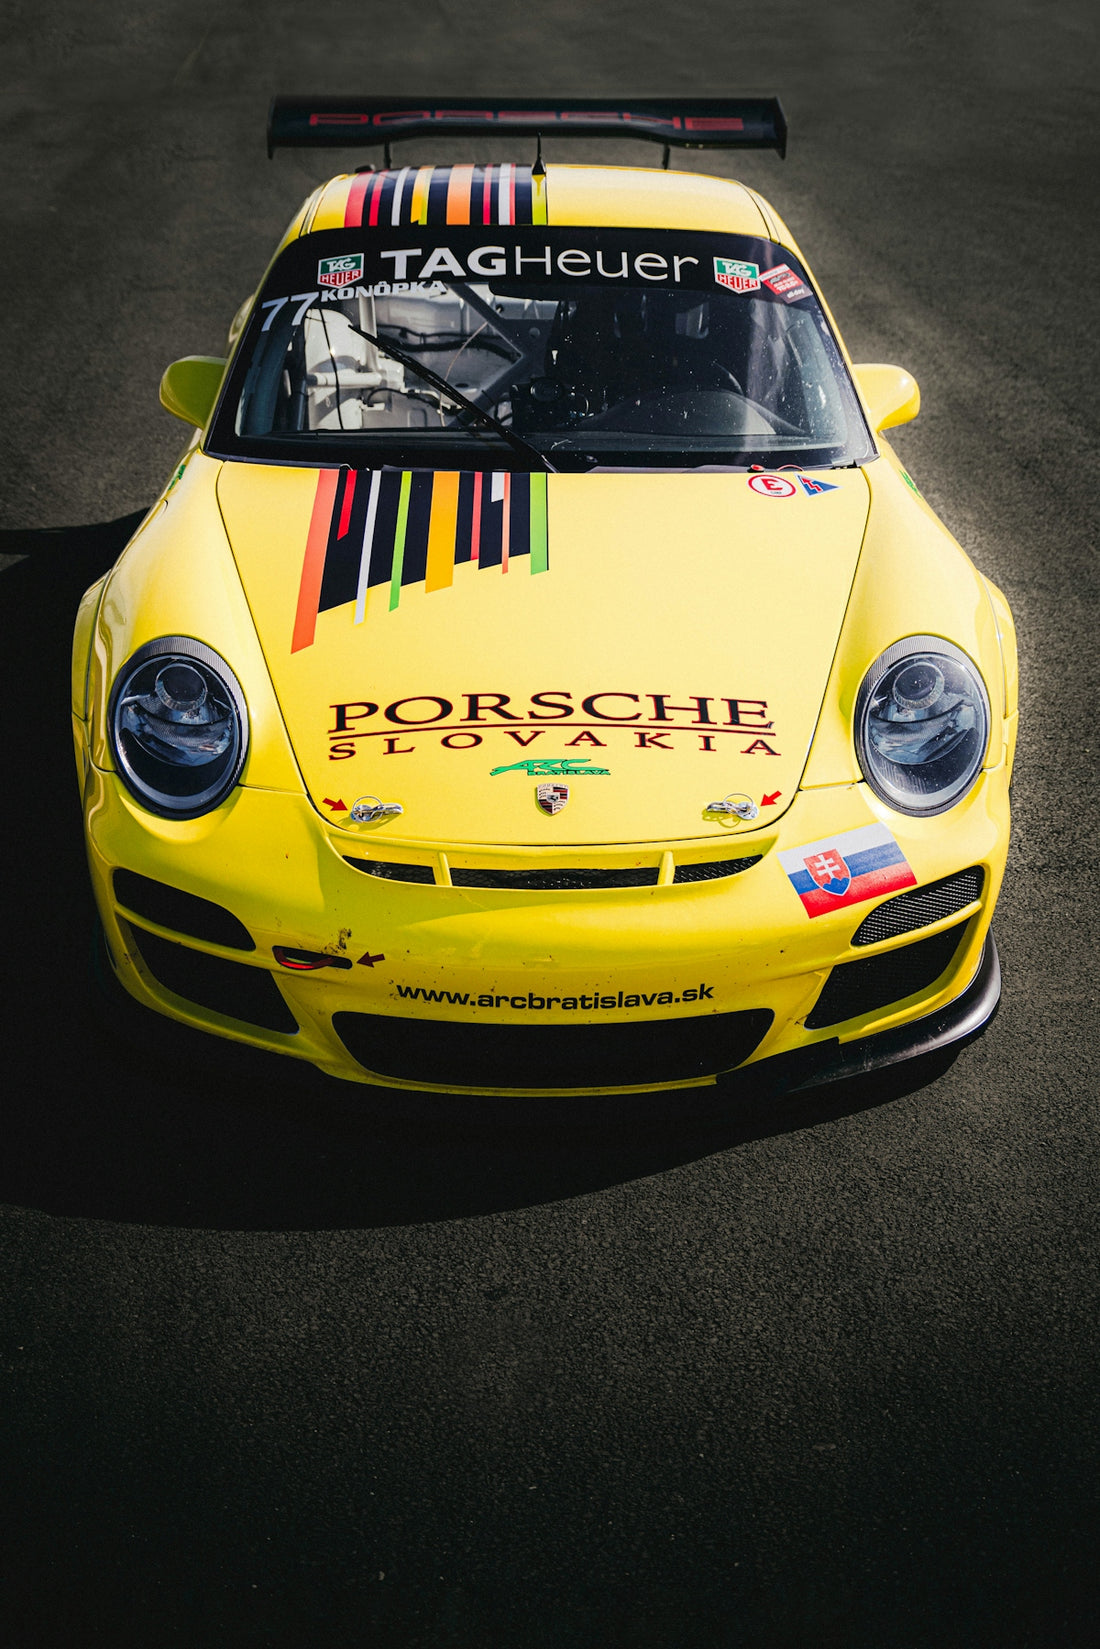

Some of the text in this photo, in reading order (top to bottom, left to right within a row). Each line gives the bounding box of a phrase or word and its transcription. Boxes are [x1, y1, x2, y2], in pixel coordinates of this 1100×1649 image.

[326, 257, 356, 273] TAG
[722, 260, 752, 277] TAG
[320, 270, 362, 286] HEUER
[717, 273, 758, 290] HEUER
[261, 292, 319, 332] 77
[328, 692, 775, 733] PORSCHE
[329, 730, 781, 760] SLOVAKIA
[396, 983, 715, 1010] www.arcbratislava.sk
